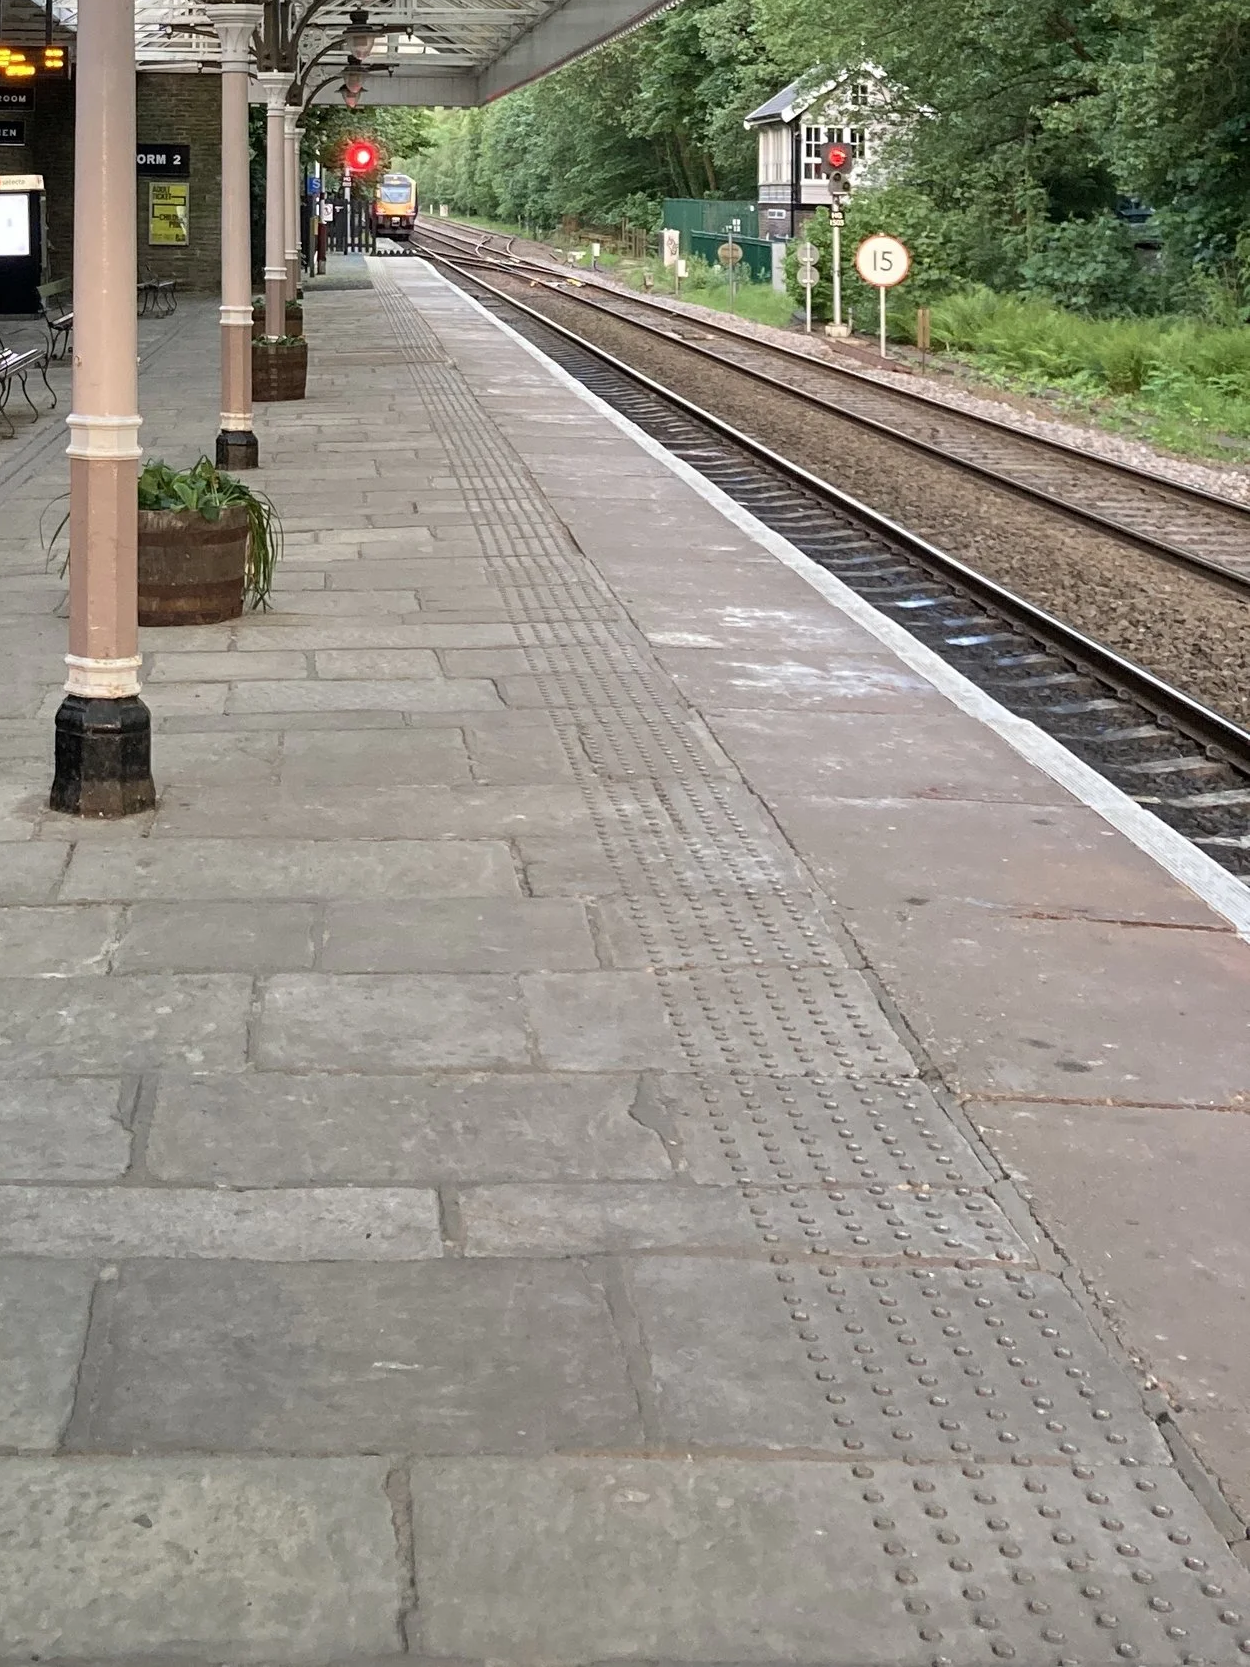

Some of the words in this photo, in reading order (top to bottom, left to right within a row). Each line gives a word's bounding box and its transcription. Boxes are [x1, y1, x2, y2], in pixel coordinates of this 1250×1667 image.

[137, 154, 167, 165] ORM
[172, 154, 182, 165] 2
[873, 250, 893, 271] 15
